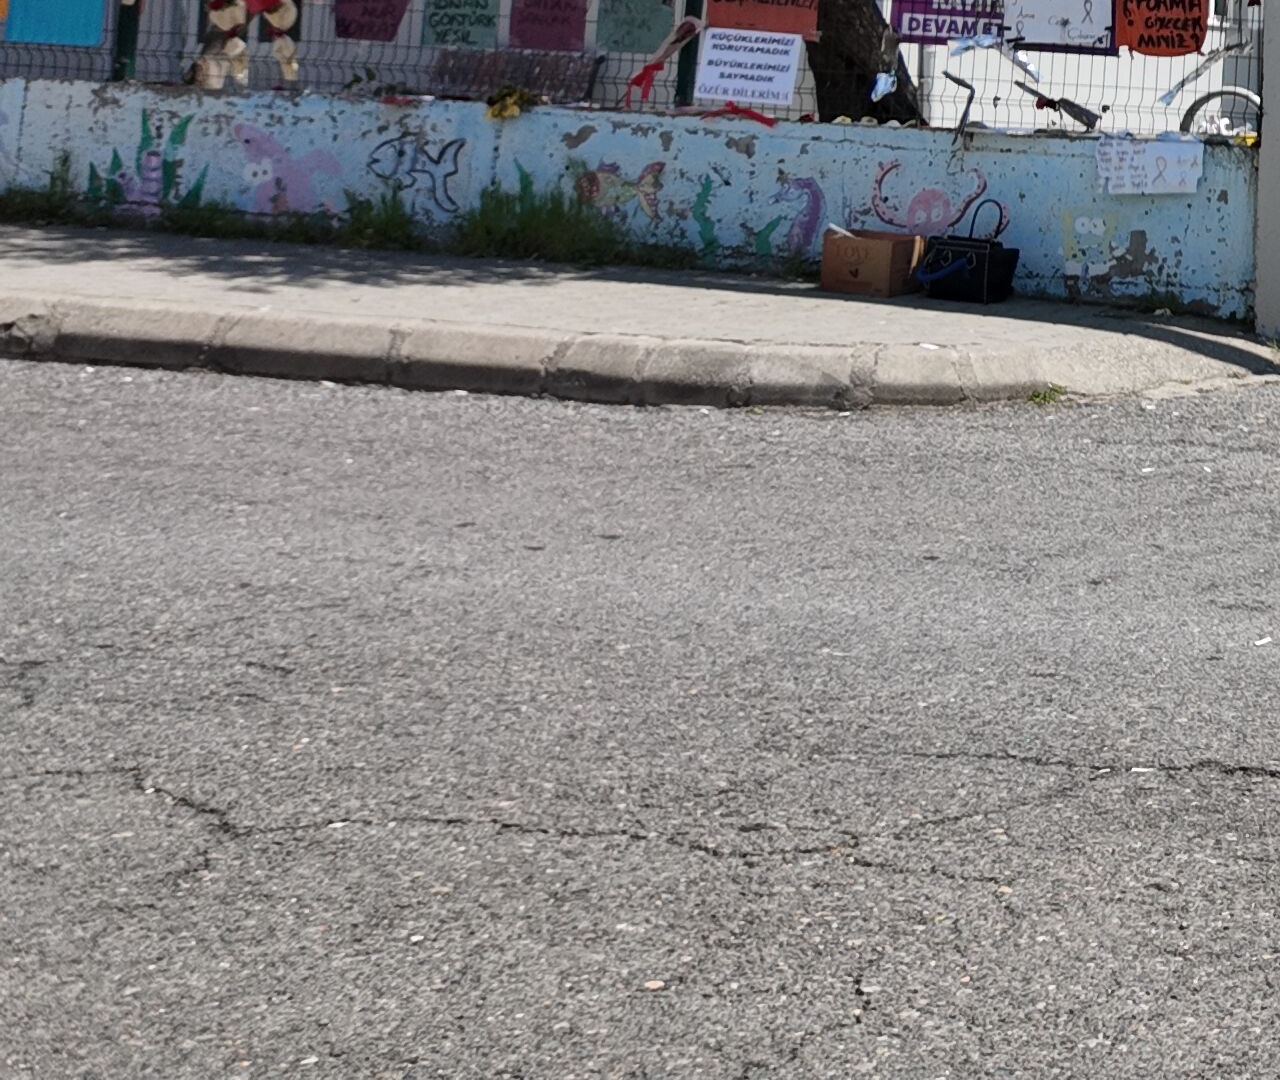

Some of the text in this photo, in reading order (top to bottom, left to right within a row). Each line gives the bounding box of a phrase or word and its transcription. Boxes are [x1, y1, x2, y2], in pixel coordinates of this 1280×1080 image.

[908, 16, 976, 38] DEVAM
[711, 32, 796, 47] KÜÇÜKLERİMİZİ
[712, 43, 791, 56] KORUYAMADIK
[707, 59, 791, 73] BÜYÜKLERİMİZİ
[718, 72, 775, 83] SAYMADIK
